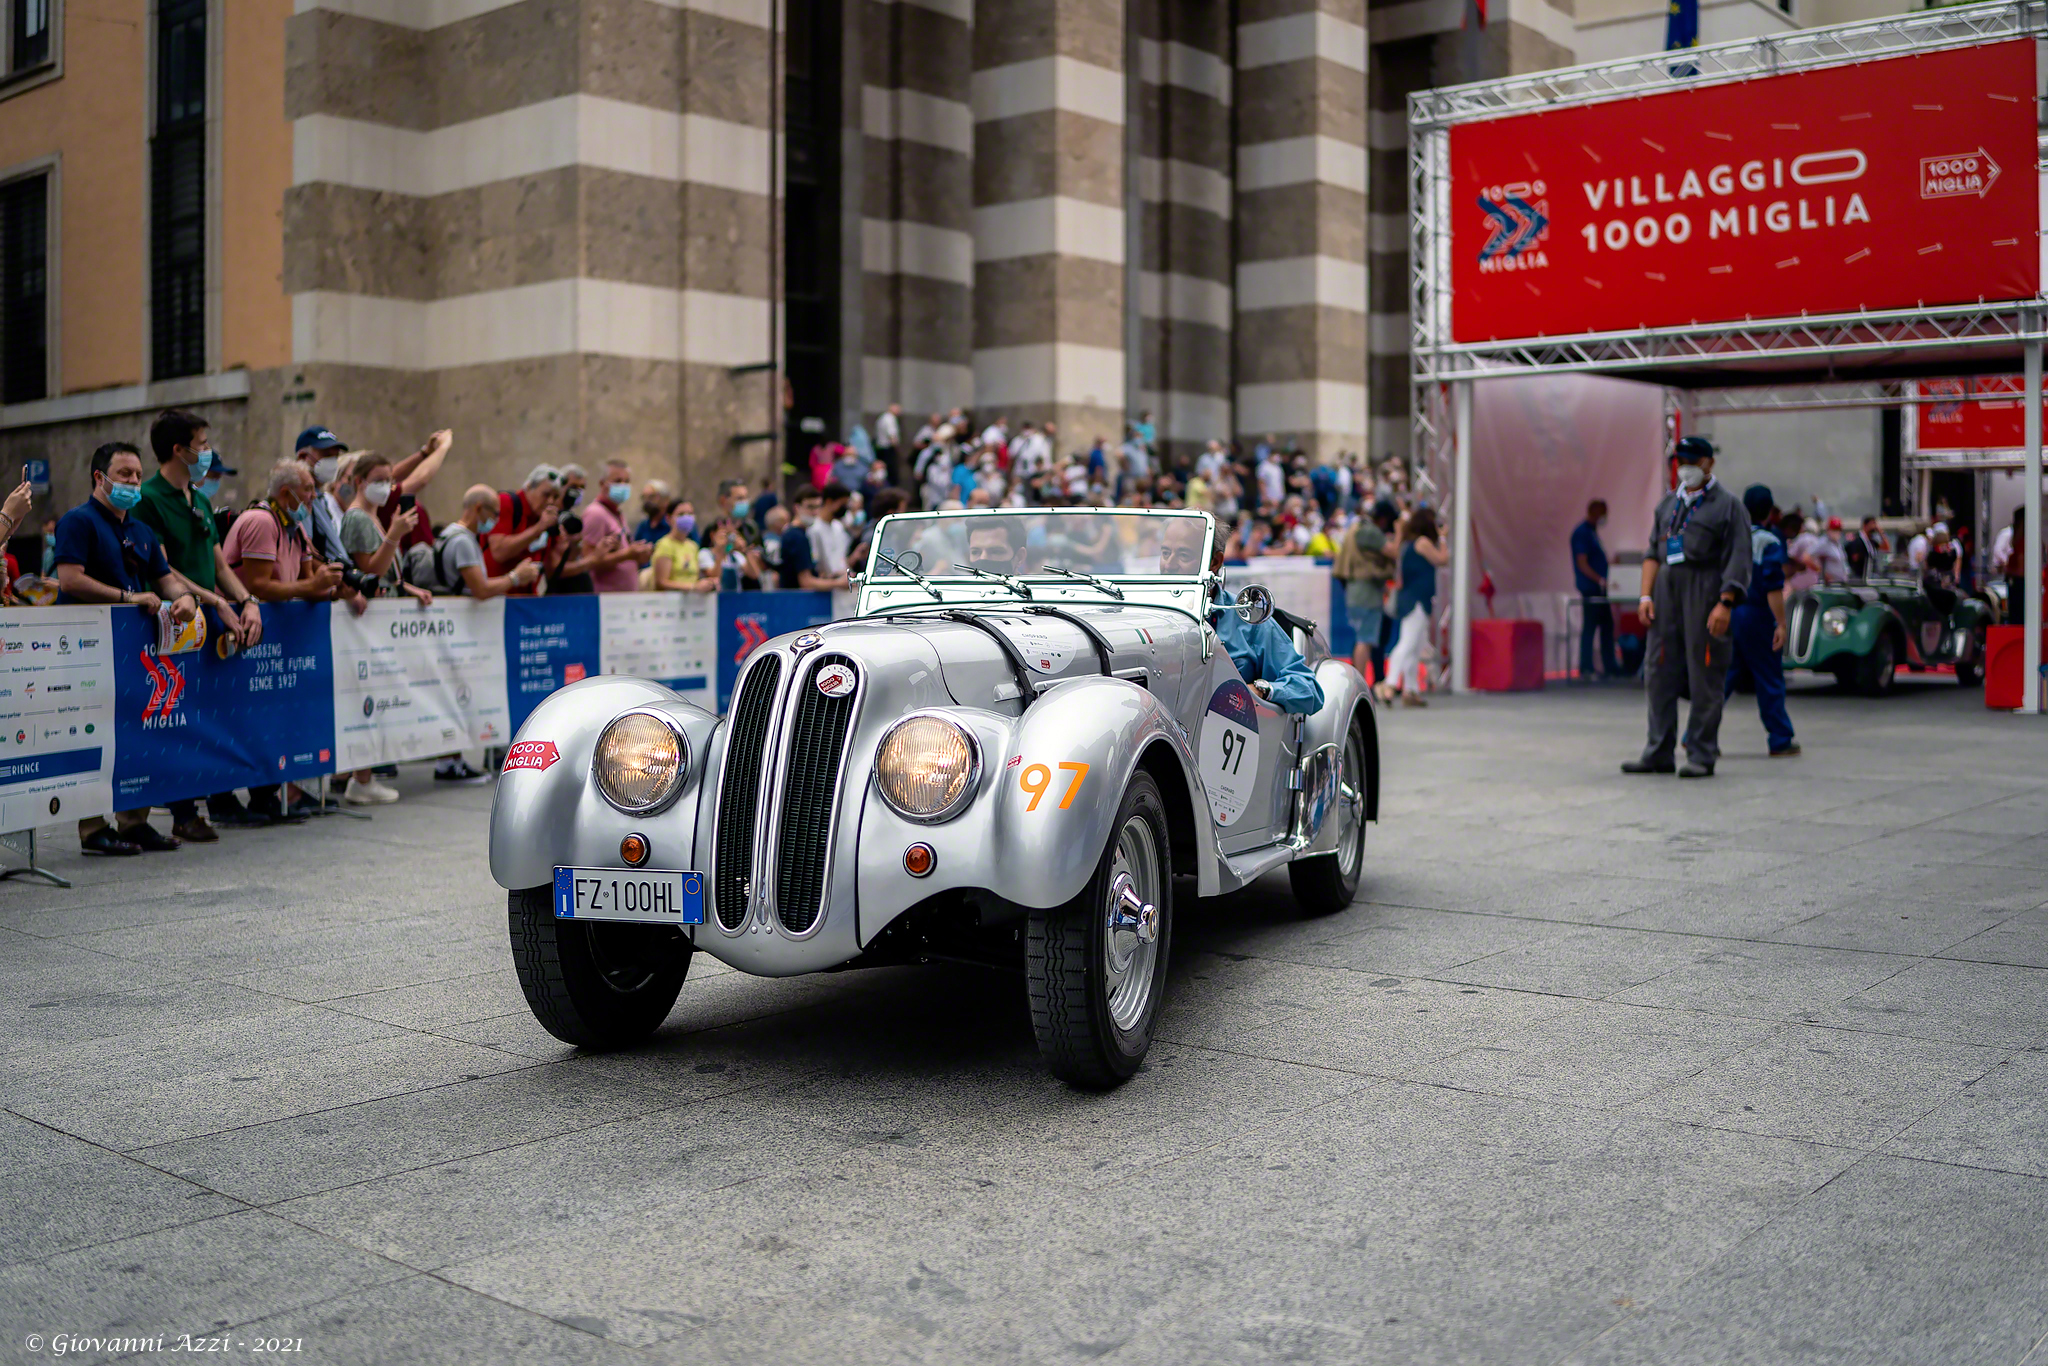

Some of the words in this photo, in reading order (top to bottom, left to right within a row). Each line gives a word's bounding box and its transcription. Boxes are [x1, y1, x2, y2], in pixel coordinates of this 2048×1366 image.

[1927, 157, 1979, 177] 1000
[1582, 148, 1867, 211] VILLAGGIO
[1925, 174, 1983, 195] MIGLIA
[1480, 179, 1548, 203] 1000
[1581, 212, 1692, 253] 1000
[1708, 192, 1871, 240] MIGLIA
[1479, 251, 1549, 274] MIGLIA
[391, 619, 455, 639] CHOPARD
[288, 656, 317, 671] FUTURE
[249, 675, 273, 691] SINCE
[278, 673, 297, 689] 1927
[142, 712, 187, 730] MIGLIA
[512, 743, 545, 755] 1000
[1221, 729, 1247, 775] 97
[505, 755, 543, 769] MIGLIA
[1020, 761, 1090, 812] 97
